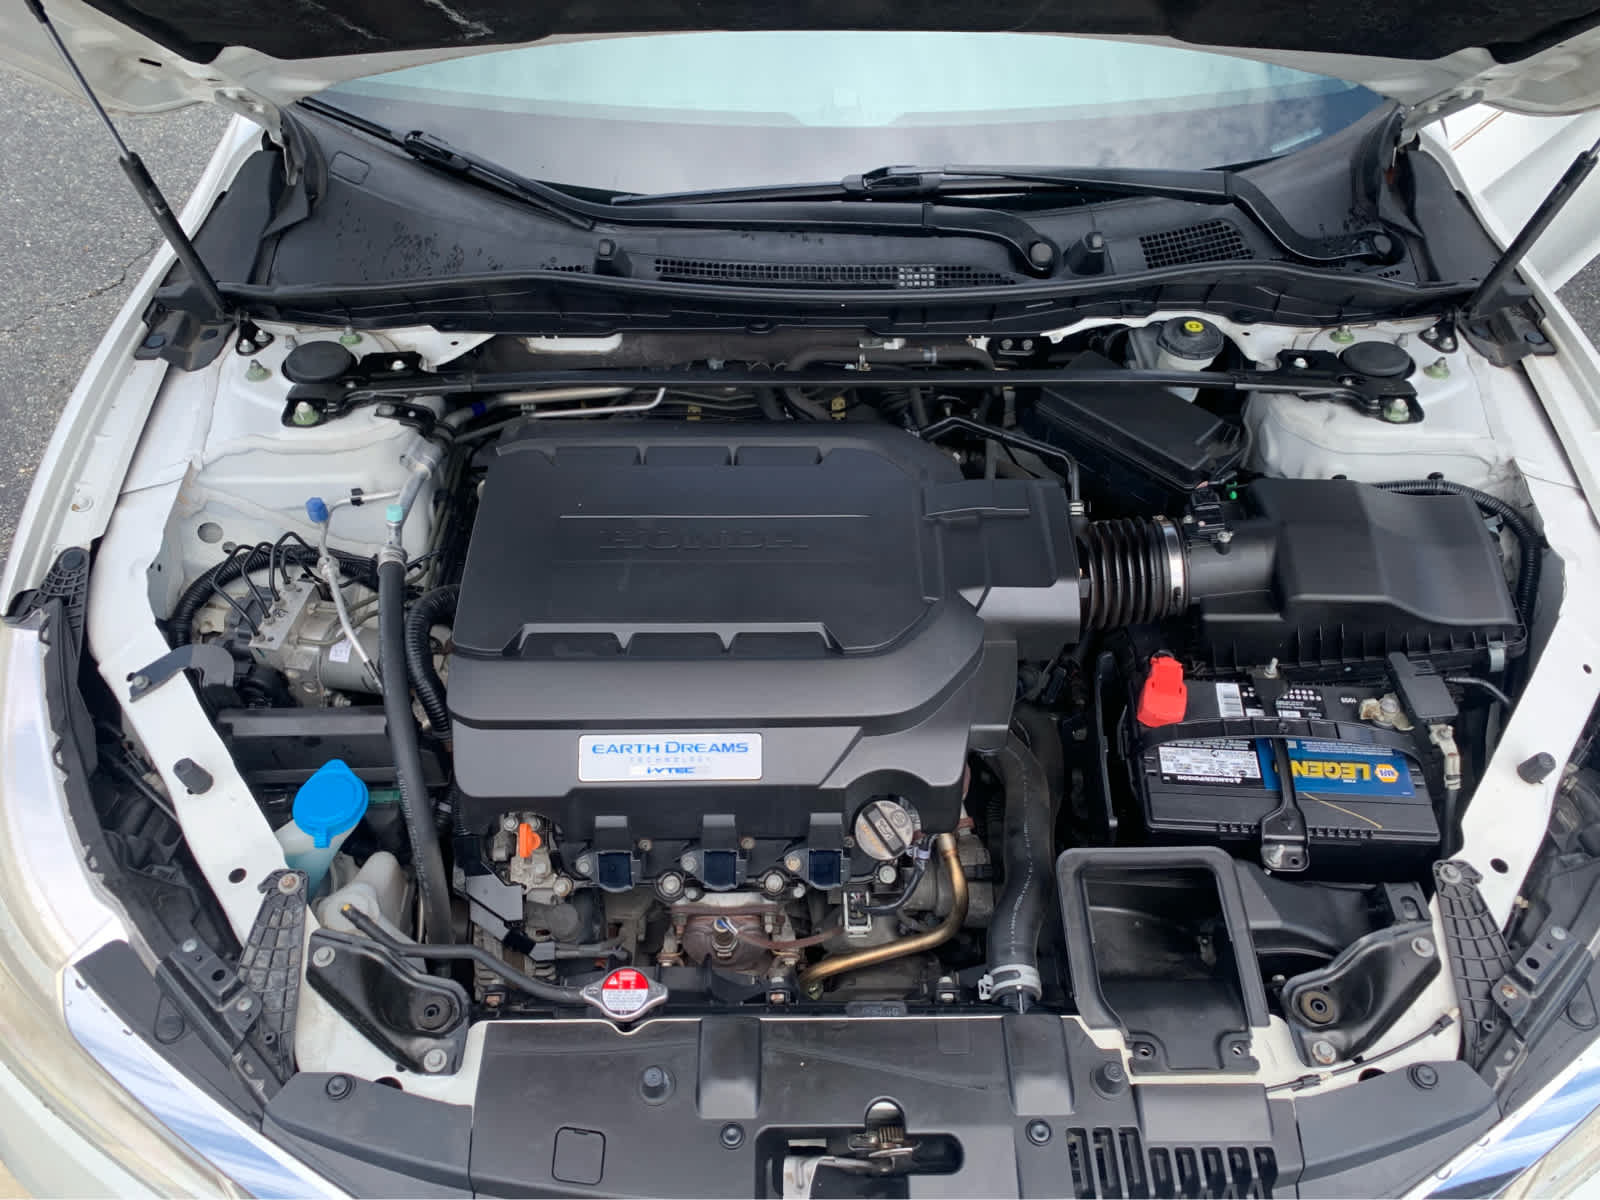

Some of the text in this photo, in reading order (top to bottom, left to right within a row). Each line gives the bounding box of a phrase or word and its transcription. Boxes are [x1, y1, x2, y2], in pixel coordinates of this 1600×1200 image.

[599, 529, 809, 551] HONDA
[592, 741, 749, 754] EARTH DREAMS
[1272, 760, 1370, 781] LEGEN
